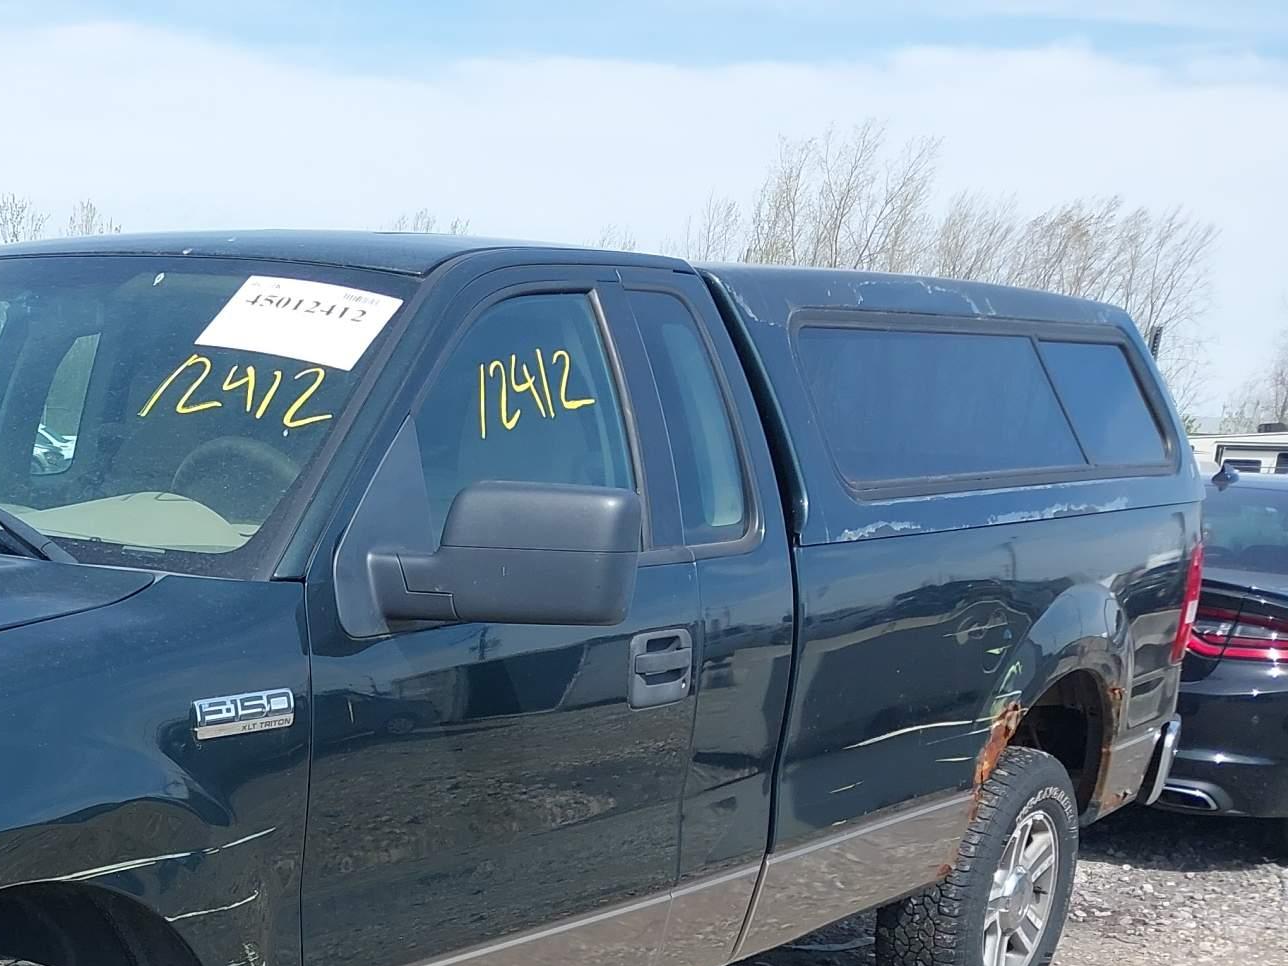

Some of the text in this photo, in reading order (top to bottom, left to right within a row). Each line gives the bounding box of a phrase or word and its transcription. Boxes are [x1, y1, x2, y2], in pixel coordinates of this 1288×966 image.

[245, 293, 367, 323] 45012412
[137, 354, 333, 428] 12412
[478, 348, 596, 440] 12412
[241, 717, 292, 732] XLT TRITON
